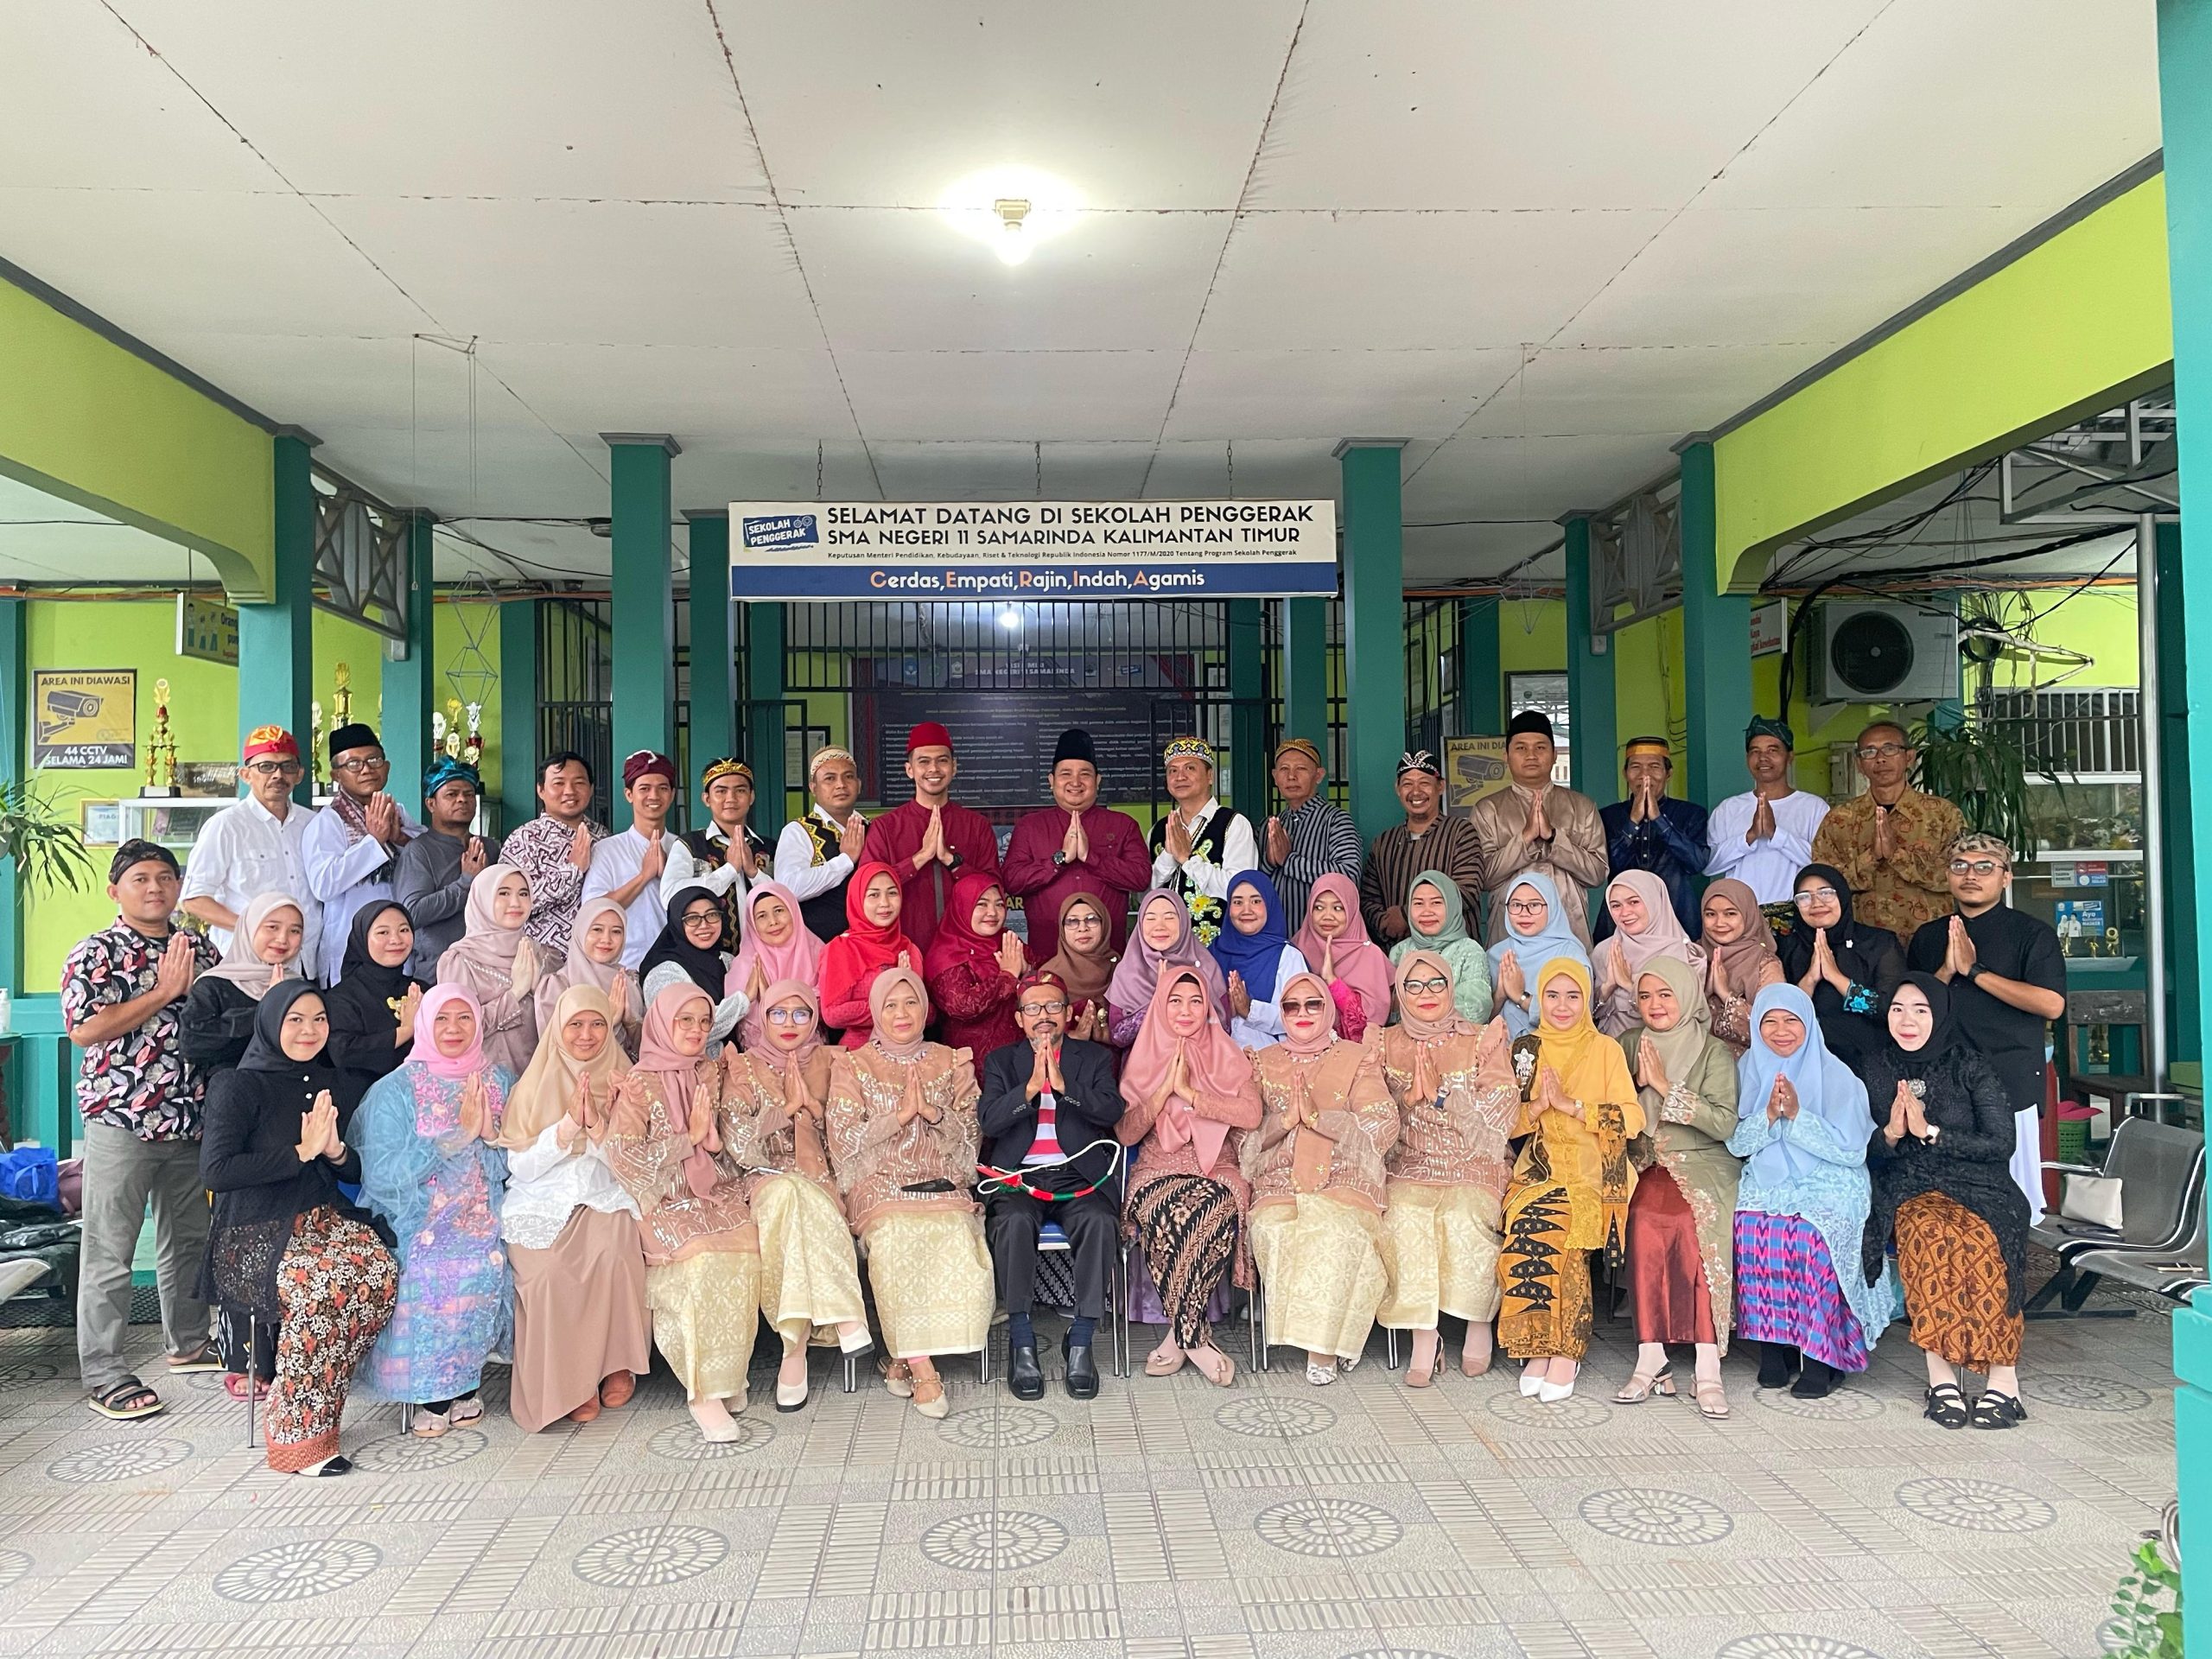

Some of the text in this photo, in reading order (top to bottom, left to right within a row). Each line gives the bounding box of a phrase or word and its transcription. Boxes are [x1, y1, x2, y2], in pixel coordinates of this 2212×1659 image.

[827, 505, 1314, 524] SELAMAT DATANG DI SEKOLAH PENGGERAK
[748, 519, 791, 534] SEKOLAH
[750, 528, 806, 545] PENGGERAK
[828, 527, 1300, 545] SMA NEGERI 11 SAMARINDA KALIMANTAN TIMUR
[1262, 549, 1297, 557] Penggerak
[870, 569, 1205, 593] Cerdas, Empati, Rajin, Indah, Agamis
[41, 676, 130, 686] AREA INI DIAWASI
[64, 745, 108, 755] 44 CCTV
[1451, 742, 1476, 752] AREA
[1477, 741, 1490, 751] INI
[46, 754, 86, 766] SELAMA
[87, 755, 102, 765] 24
[1006, 896, 1025, 910] AR
